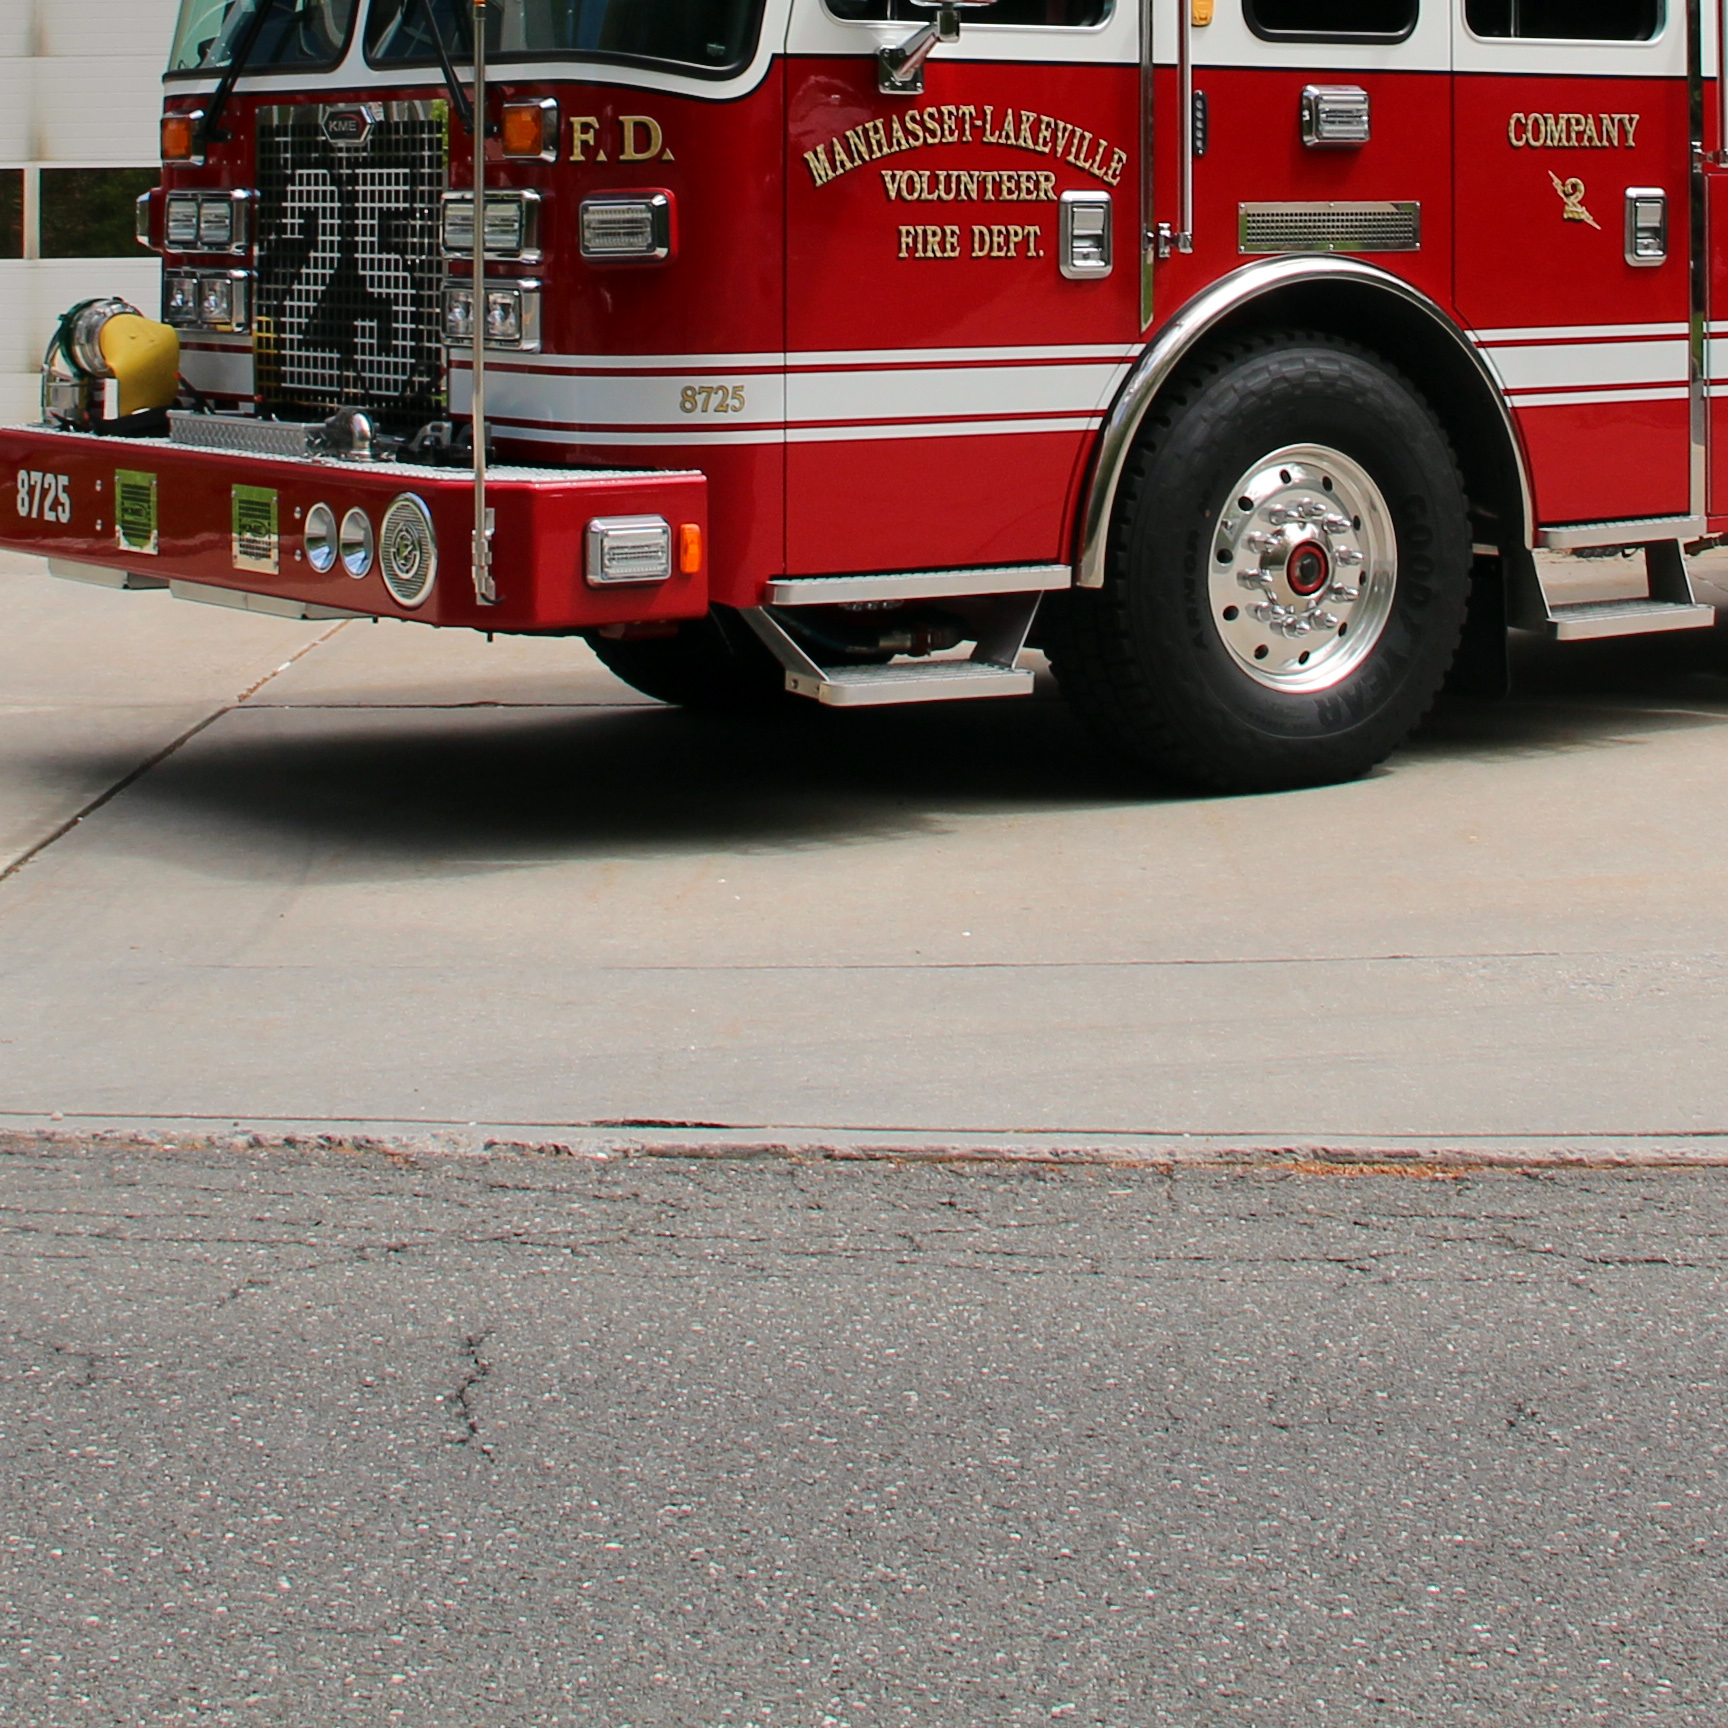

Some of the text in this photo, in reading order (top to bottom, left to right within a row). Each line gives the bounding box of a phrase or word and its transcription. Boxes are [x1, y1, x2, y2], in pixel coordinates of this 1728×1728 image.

[329, 120, 357, 132] KME
[1508, 112, 1640, 147] COMPANY
[803, 105, 1129, 188] MANHASSET-LAKEVILLE
[881, 169, 1058, 202] VOLUNTEER
[897, 224, 1046, 259] FIRE DEPT.
[679, 384, 746, 413] 8725
[16, 469, 71, 524] 8725
